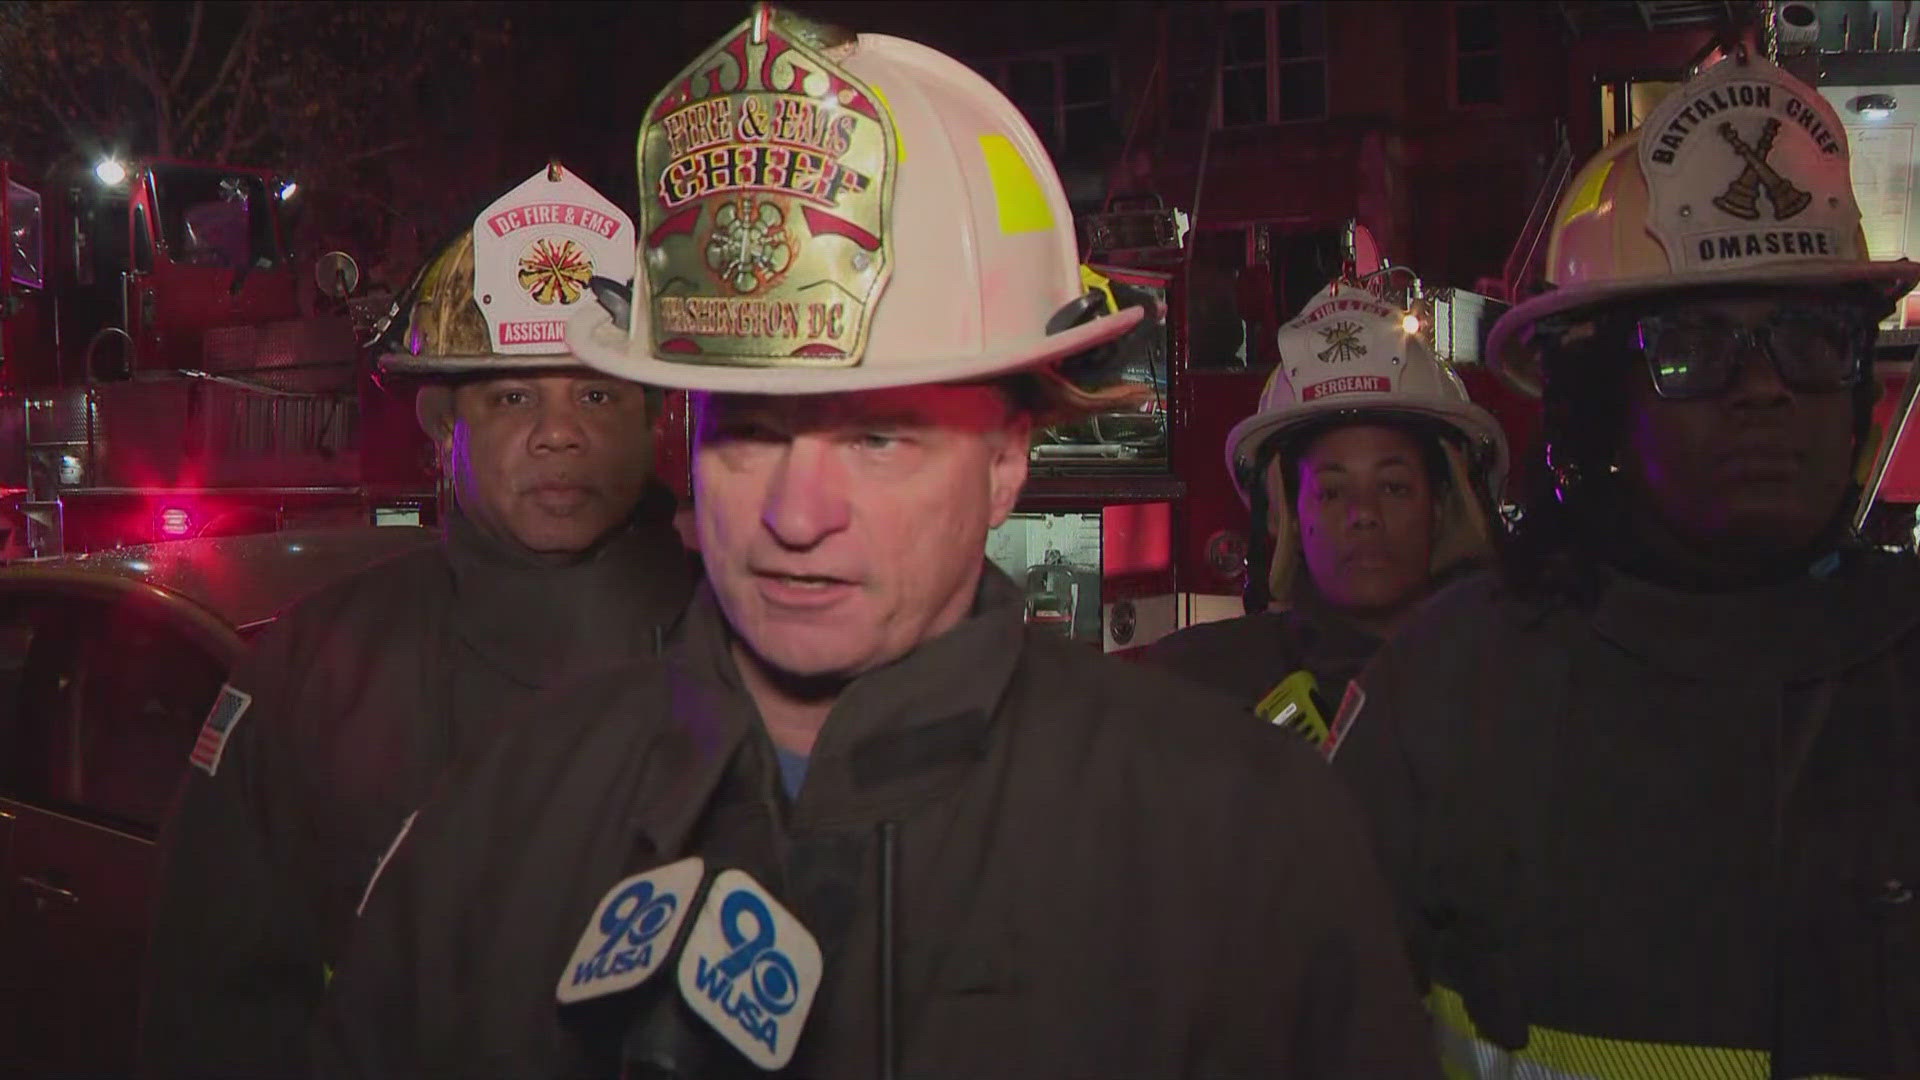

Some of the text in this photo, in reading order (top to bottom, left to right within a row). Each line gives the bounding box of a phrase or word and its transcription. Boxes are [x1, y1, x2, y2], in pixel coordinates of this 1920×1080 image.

[663, 94, 857, 158] FIRE & EMS
[1652, 85, 1839, 165] BATTALION CHIEF
[495, 205, 614, 237] DC FIRE & EMS
[1699, 231, 1829, 261] OMASERE
[505, 322, 564, 342] ASSISTAN
[806, 302, 844, 339] DC
[1314, 377, 1379, 398] SERGEANT
[572, 944, 652, 985] WUSA
[696, 956, 778, 1056] WUSA
